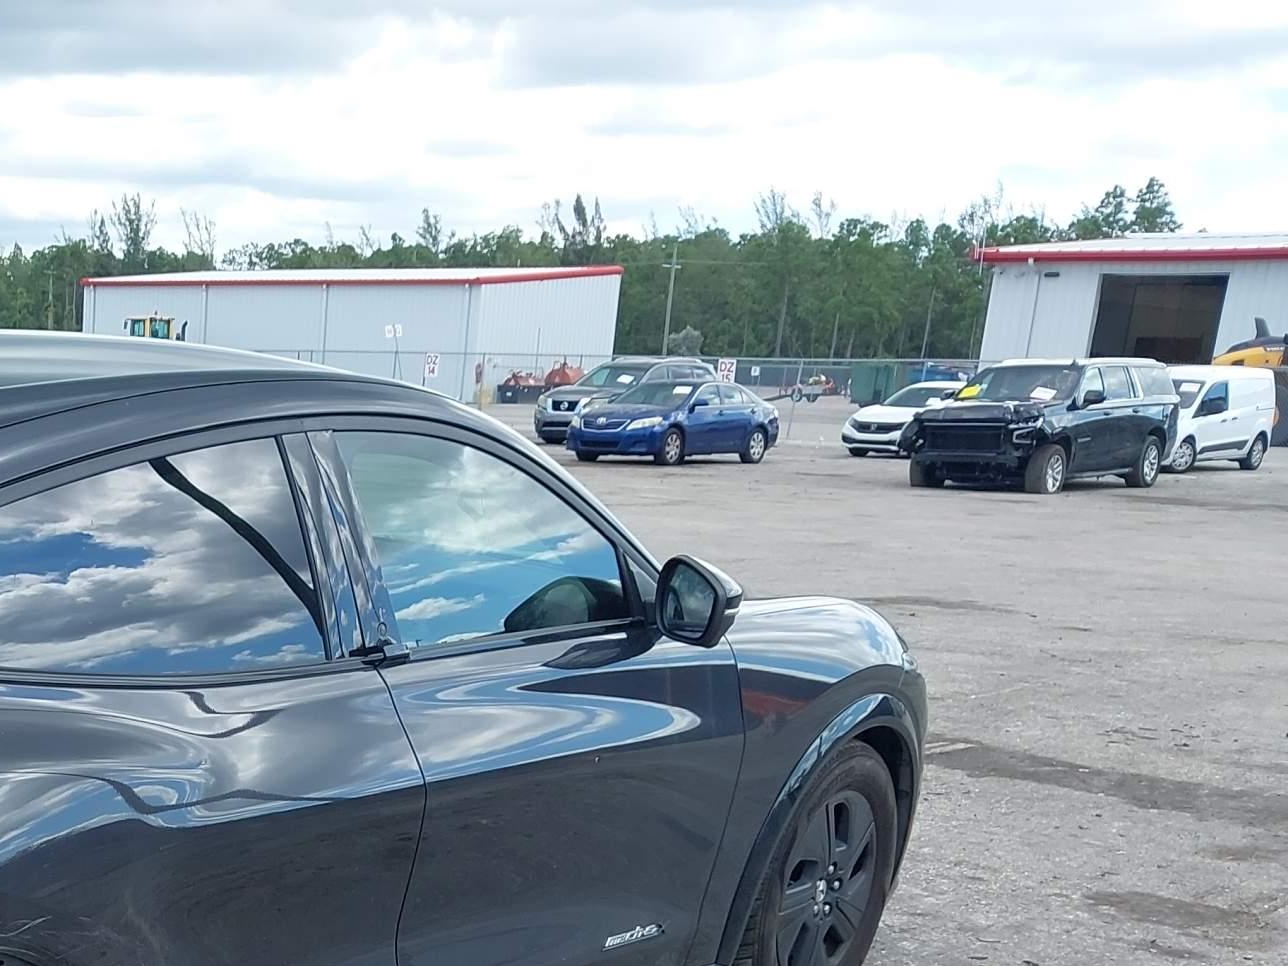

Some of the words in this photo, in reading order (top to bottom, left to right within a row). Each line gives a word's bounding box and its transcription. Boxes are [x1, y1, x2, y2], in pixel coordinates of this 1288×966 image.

[426, 355, 439, 365] DZ
[719, 361, 735, 372] DZ
[721, 373, 731, 383] 15
